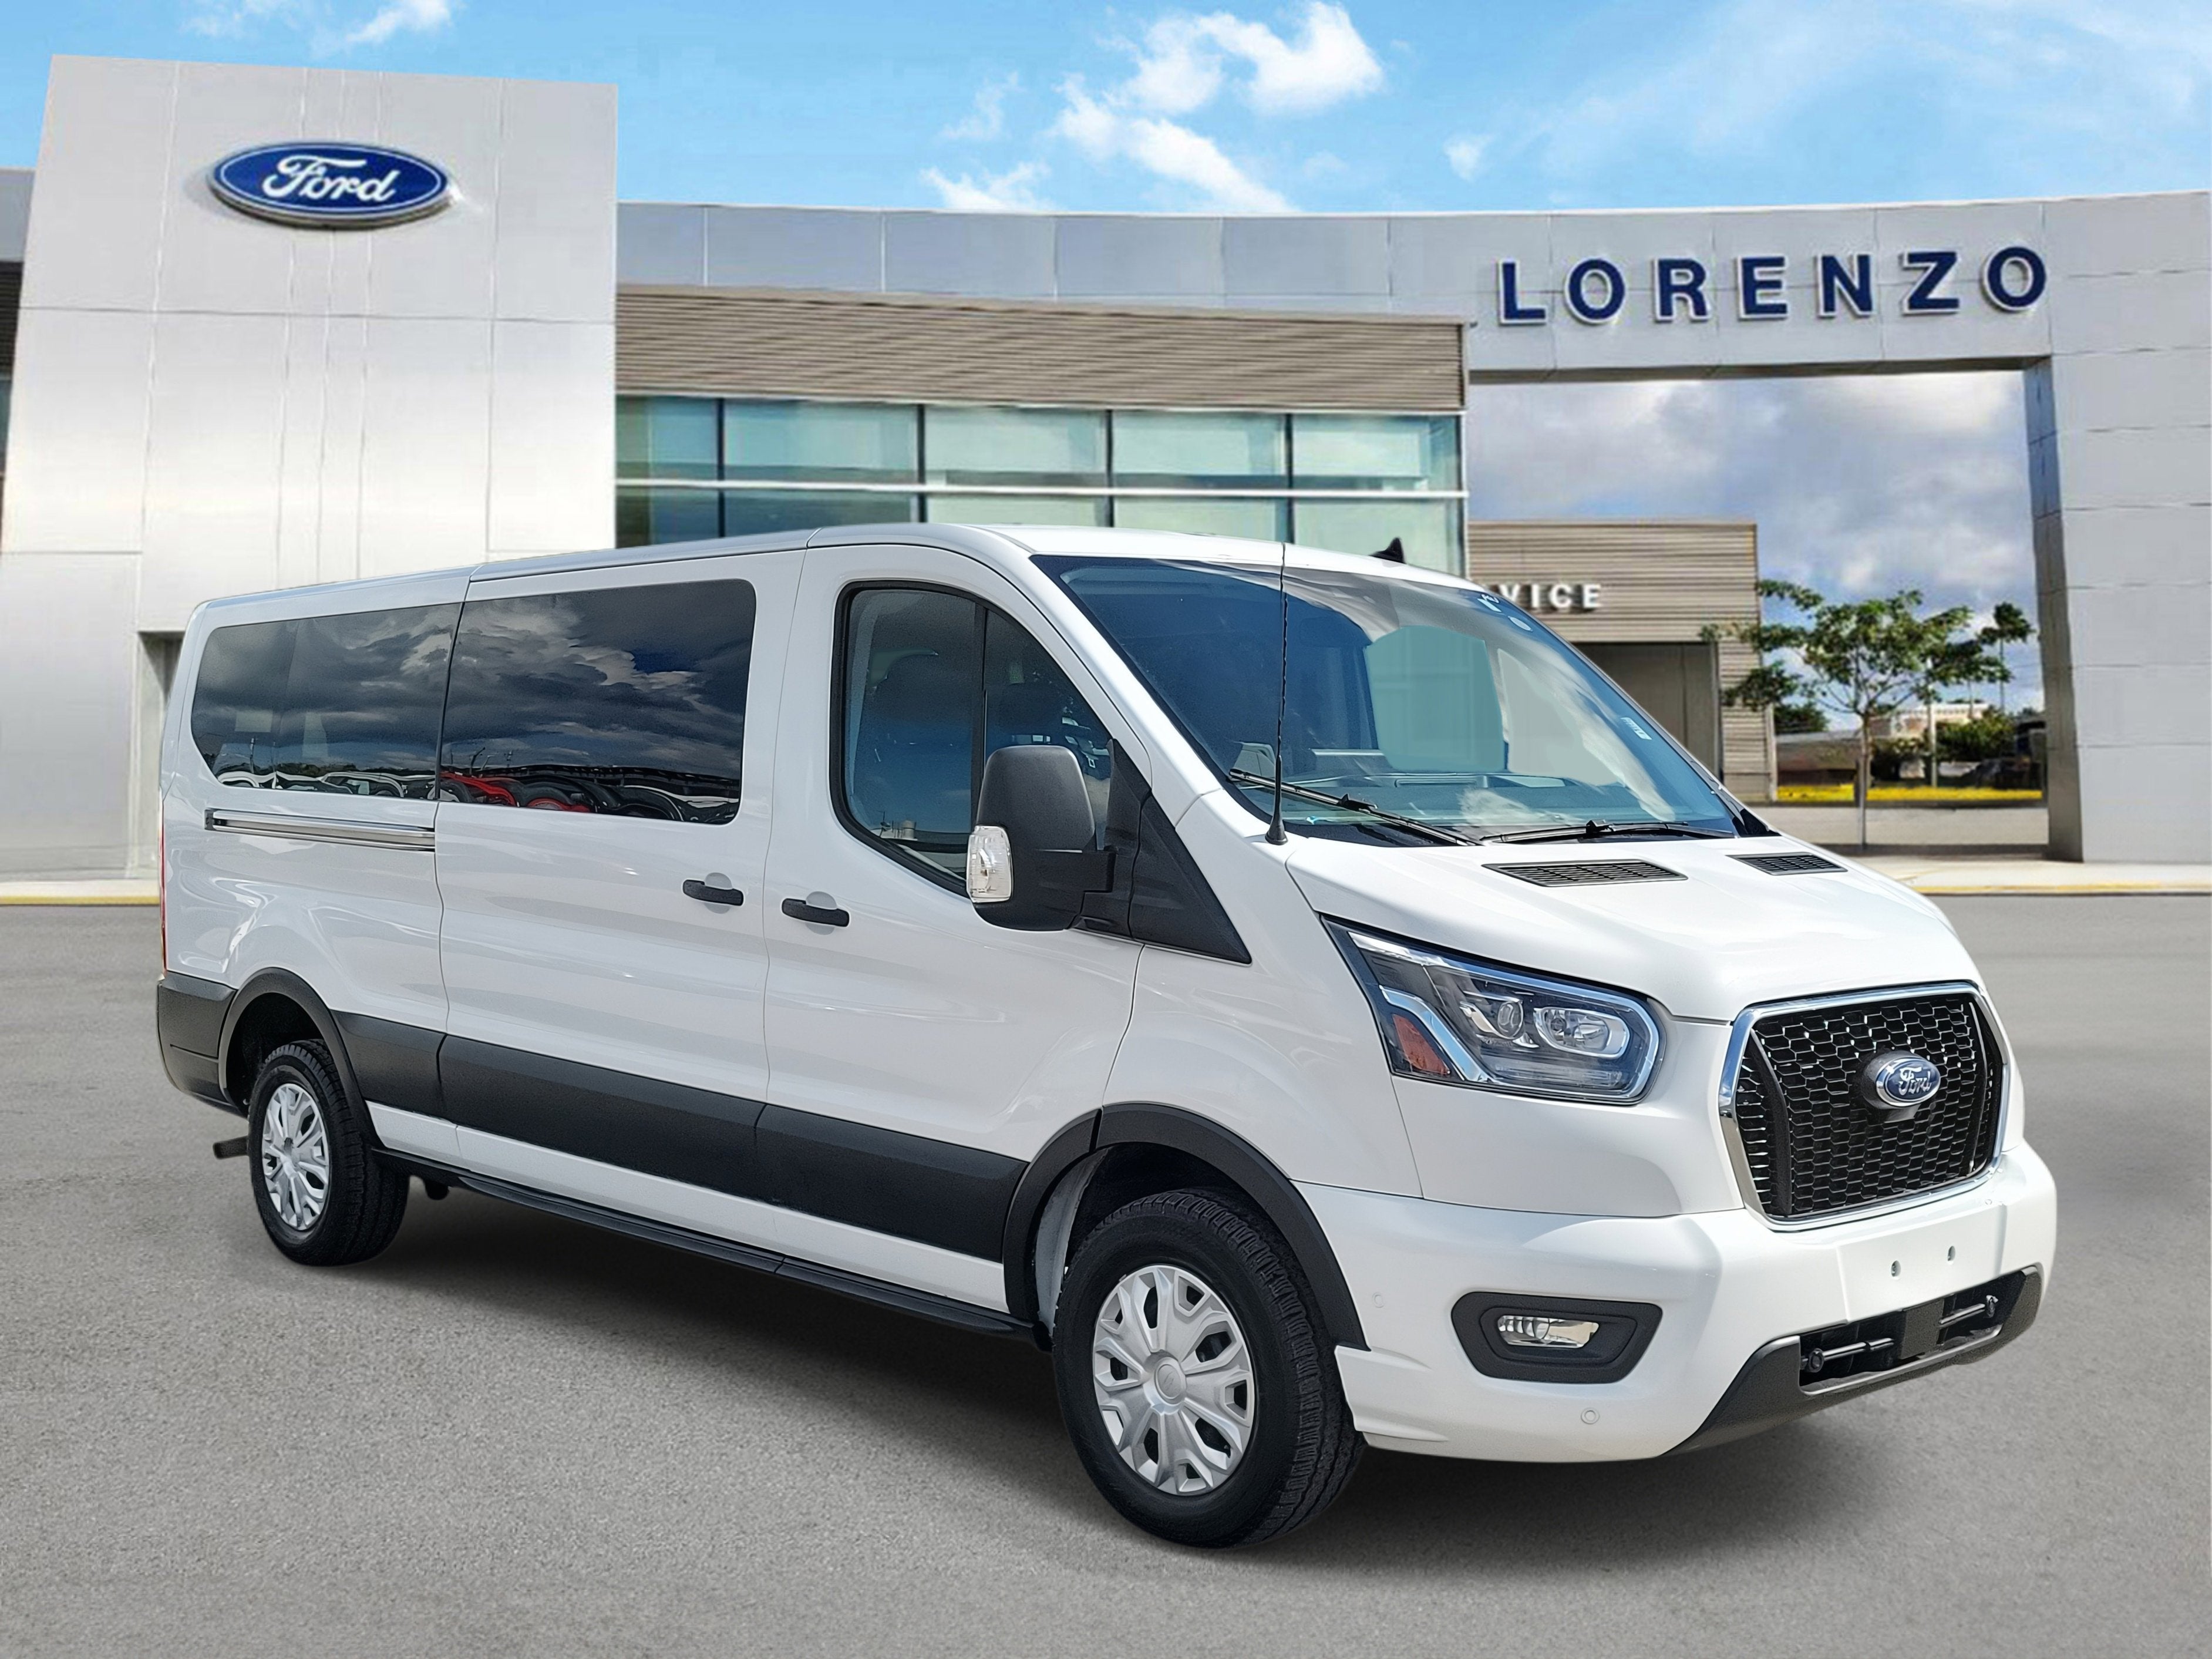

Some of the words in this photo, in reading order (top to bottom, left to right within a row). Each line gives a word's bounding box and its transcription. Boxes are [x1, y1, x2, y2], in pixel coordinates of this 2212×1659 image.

[262, 155, 400, 201] Ford
[1499, 247, 2047, 325] LORENZO
[1898, 1066, 1932, 1096] Ford
